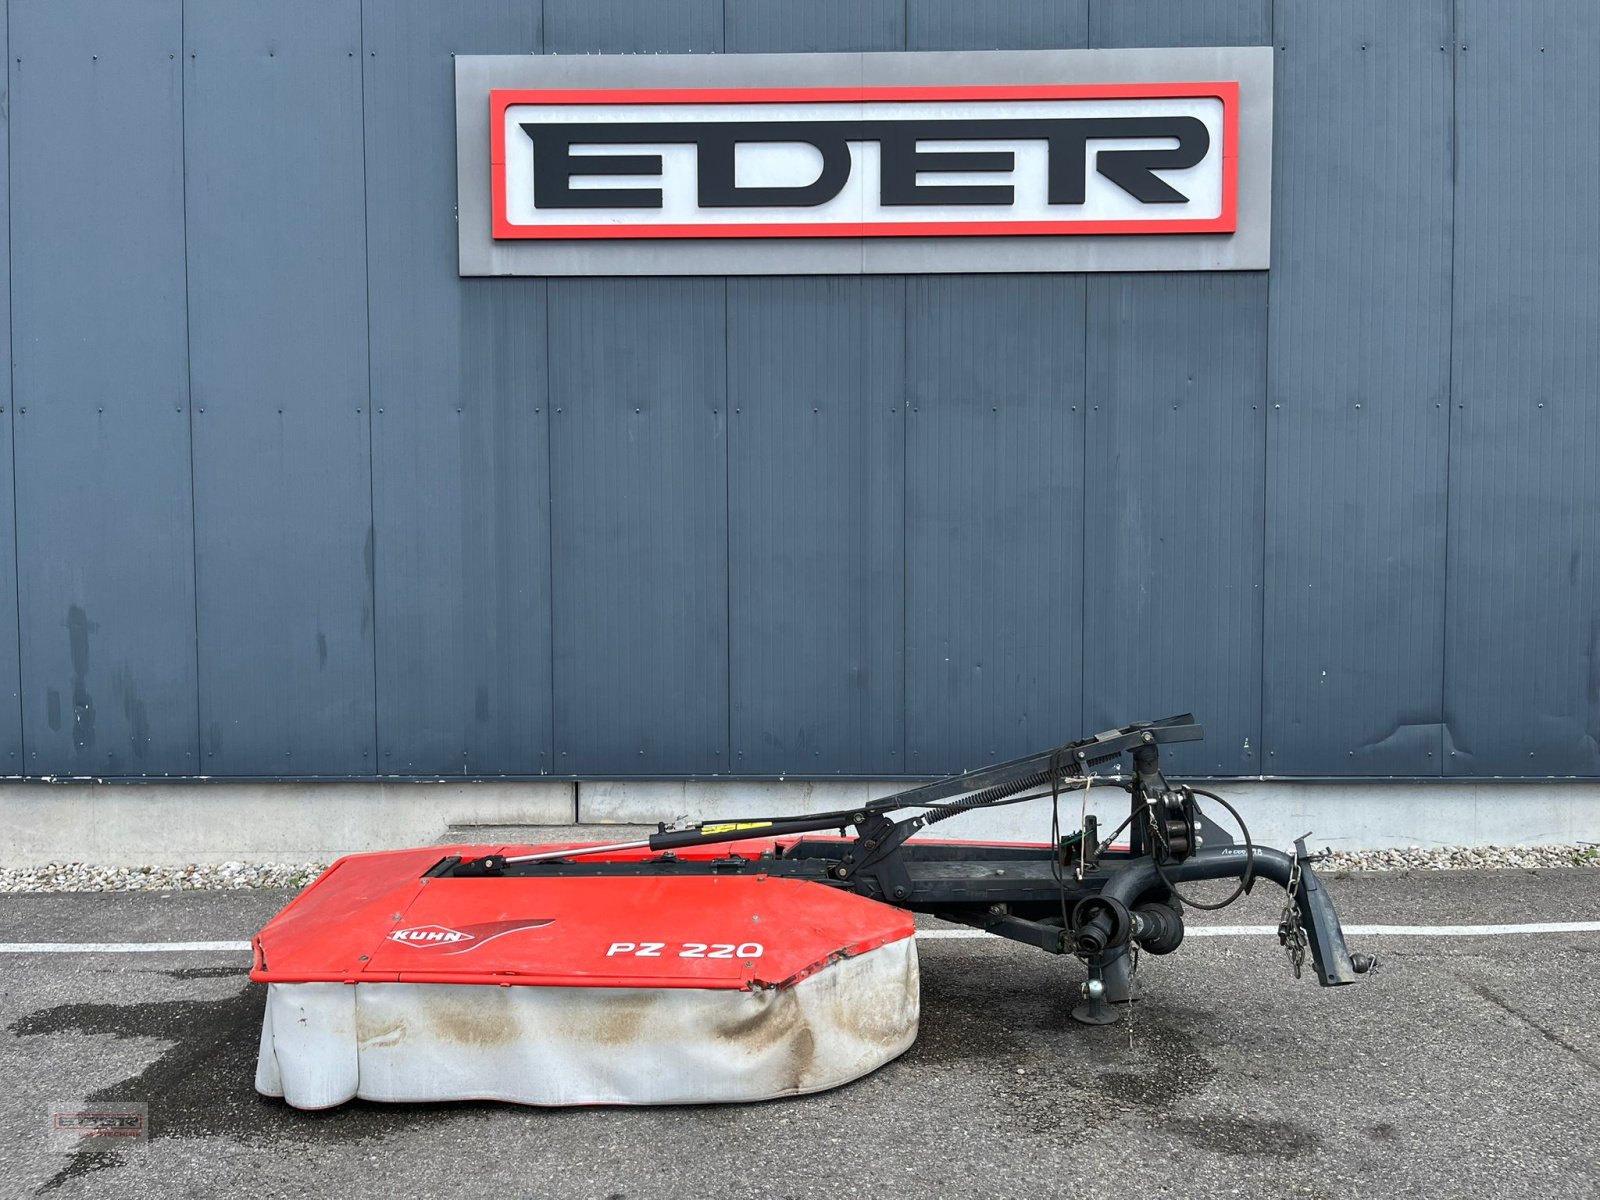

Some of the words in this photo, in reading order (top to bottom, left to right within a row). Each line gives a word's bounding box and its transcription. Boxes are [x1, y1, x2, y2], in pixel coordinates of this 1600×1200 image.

[519, 116, 1210, 209] EDER
[392, 931, 462, 941] KUHN
[605, 942, 666, 957] PZ
[678, 942, 764, 959] 220
